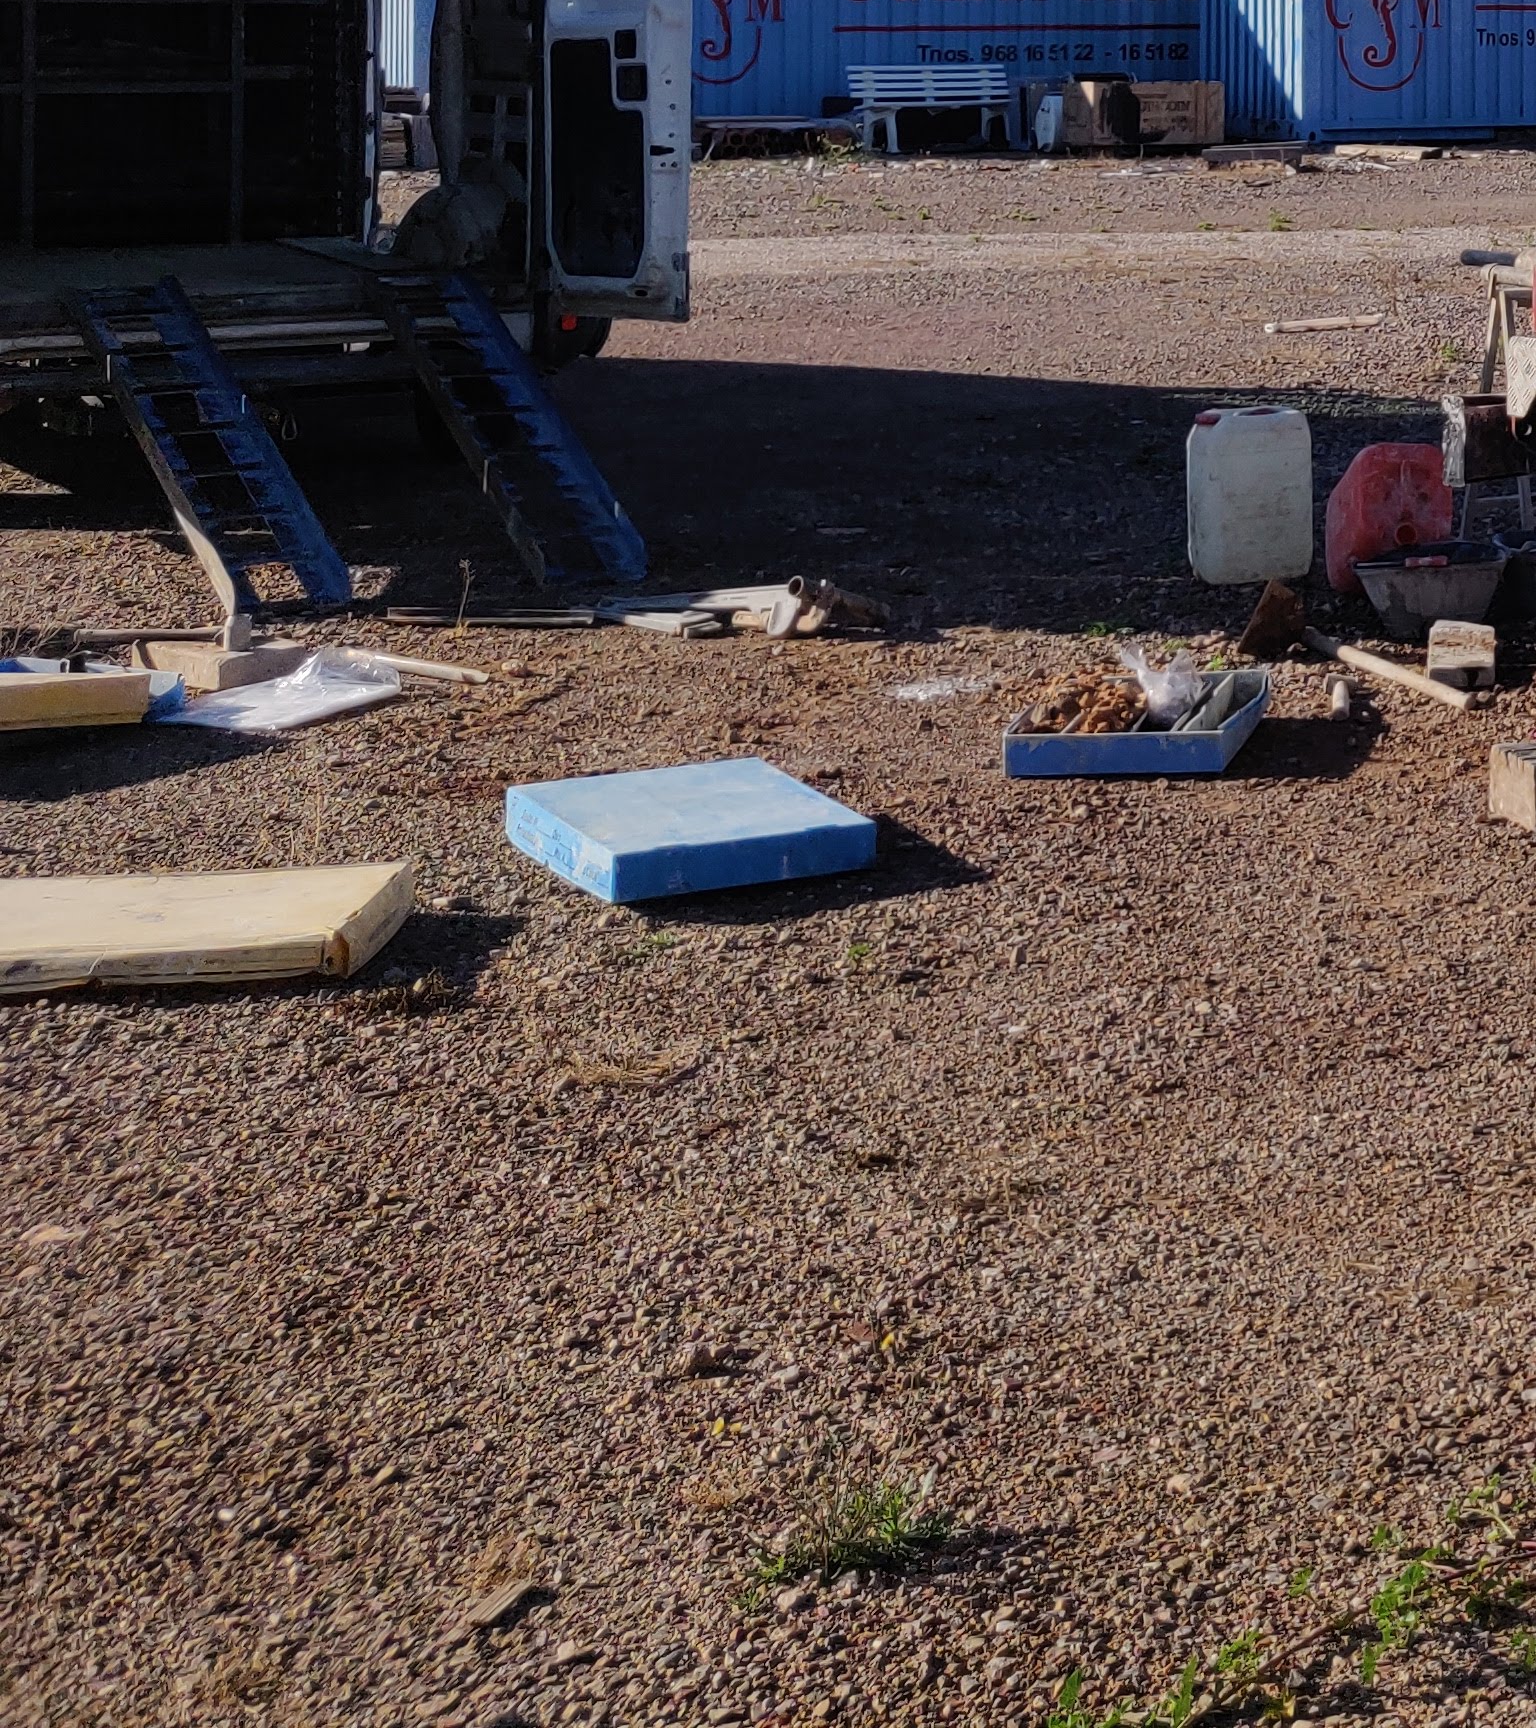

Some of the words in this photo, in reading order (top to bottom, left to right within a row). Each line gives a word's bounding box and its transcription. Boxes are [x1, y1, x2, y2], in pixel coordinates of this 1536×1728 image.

[916, 44, 975, 63] Tnos.
[980, 44, 1018, 62] 968
[1023, 44, 1044, 62] 16
[1048, 43, 1069, 61] 51
[1073, 43, 1095, 61] 22
[1118, 43, 1140, 61] 16
[1144, 43, 1164, 61] 51
[1168, 43, 1189, 61] 82
